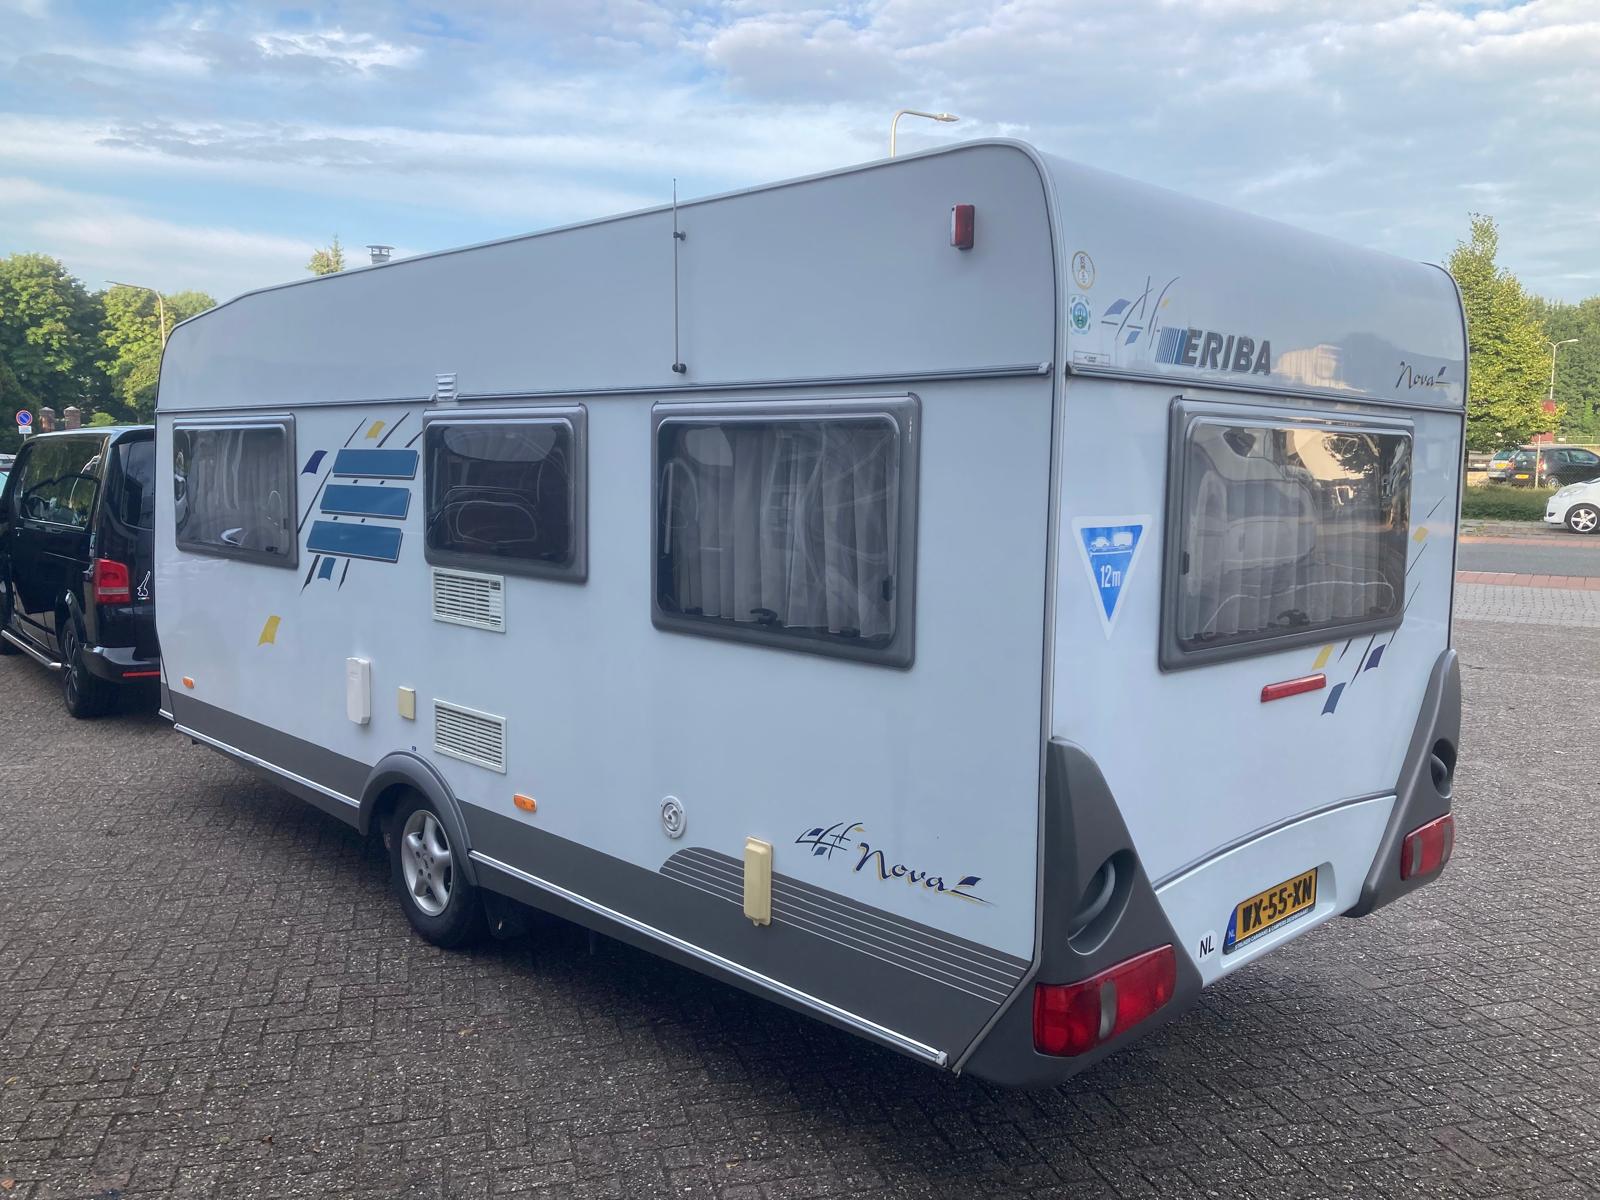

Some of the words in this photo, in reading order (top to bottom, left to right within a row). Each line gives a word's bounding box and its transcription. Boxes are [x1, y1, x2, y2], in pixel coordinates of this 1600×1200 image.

[1182, 327, 1271, 376] ERIBA
[1395, 361, 1435, 389] Nova
[853, 842, 947, 892] Nova
[1242, 875, 1313, 933] WX-55-XN
[1199, 935, 1215, 958] NL
